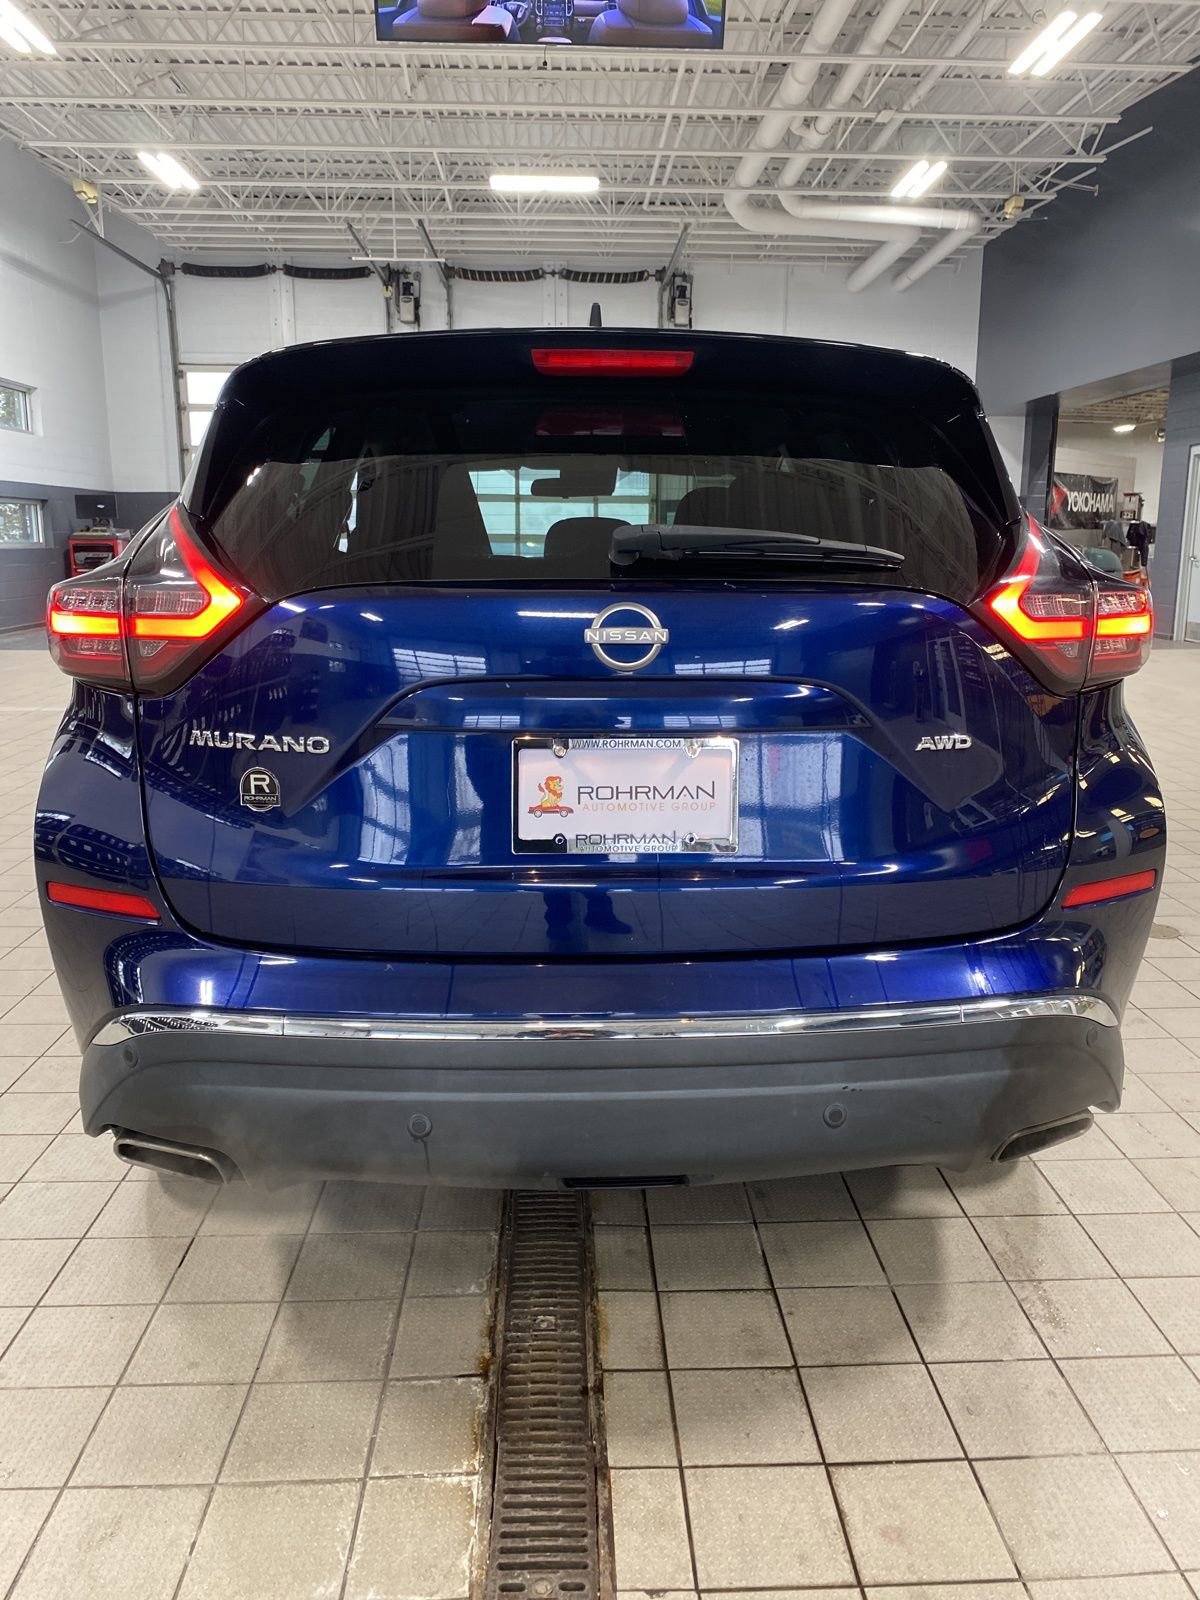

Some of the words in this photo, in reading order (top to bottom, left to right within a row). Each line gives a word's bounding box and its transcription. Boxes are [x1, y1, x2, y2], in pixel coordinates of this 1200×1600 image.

[1067, 491, 1114, 512] YOKOHAMA
[586, 630, 667, 642] NISSAN
[189, 729, 330, 754] MURANO
[571, 739, 681, 749] WWW.ROHRMAN.COM
[915, 733, 972, 751] AWD
[250, 774, 270, 795] R
[578, 780, 715, 805] ROHRMAN
[582, 802, 665, 812] AUTOMOTIVE
[671, 802, 716, 811] GROUP
[575, 830, 677, 848] ROHRMAN
